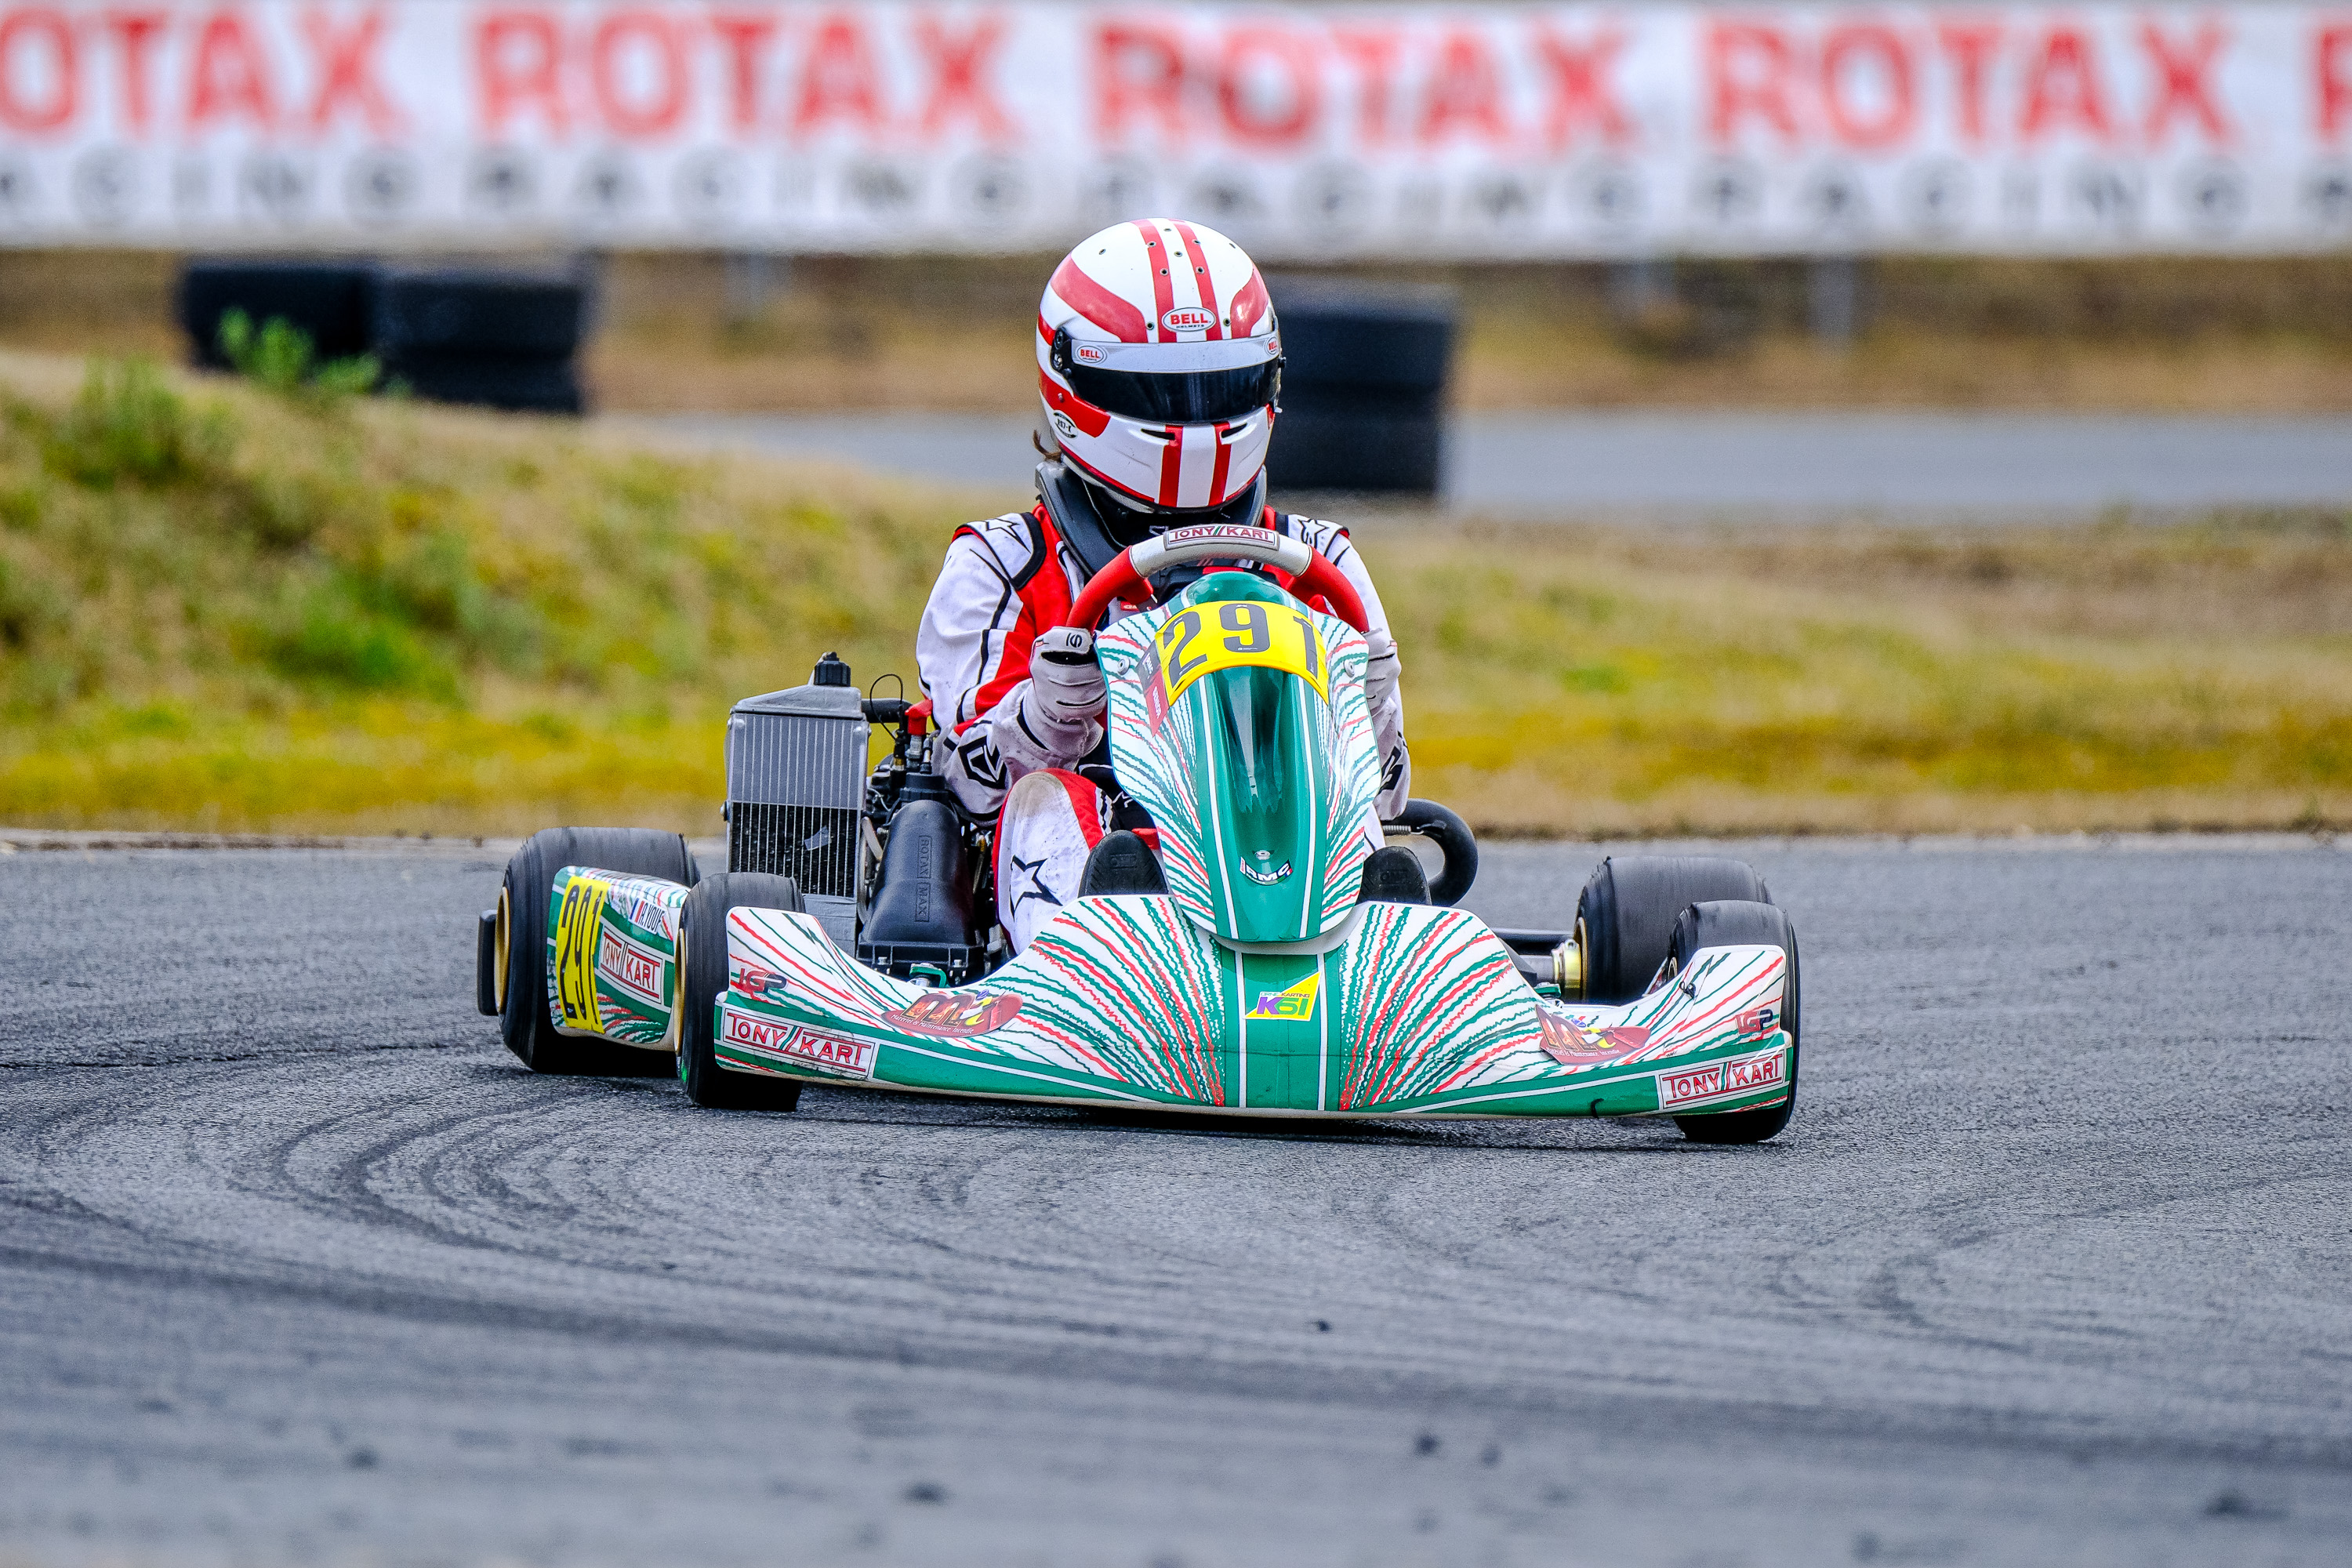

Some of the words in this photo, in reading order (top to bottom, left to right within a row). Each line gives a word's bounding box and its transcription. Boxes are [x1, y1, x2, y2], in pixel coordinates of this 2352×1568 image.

[472, 9, 1007, 136] ROTAX
[1092, 20, 1628, 149] ROTAX
[1704, 20, 2227, 147] ROTAX
[1171, 313, 1207, 325] BELL
[1080, 349, 1100, 358] BELL
[1170, 526, 1215, 539] TONY
[1226, 526, 1273, 539] KART
[1162, 603, 1318, 688] 291
[1246, 863, 1290, 881] RMC
[561, 884, 603, 1025] 291
[603, 931, 622, 973] TONY
[626, 948, 661, 991] KART
[727, 1012, 789, 1047] TONY
[798, 1030, 872, 1065] KART
[1663, 1067, 1720, 1098] TONY
[1732, 1054, 1783, 1087] KART
